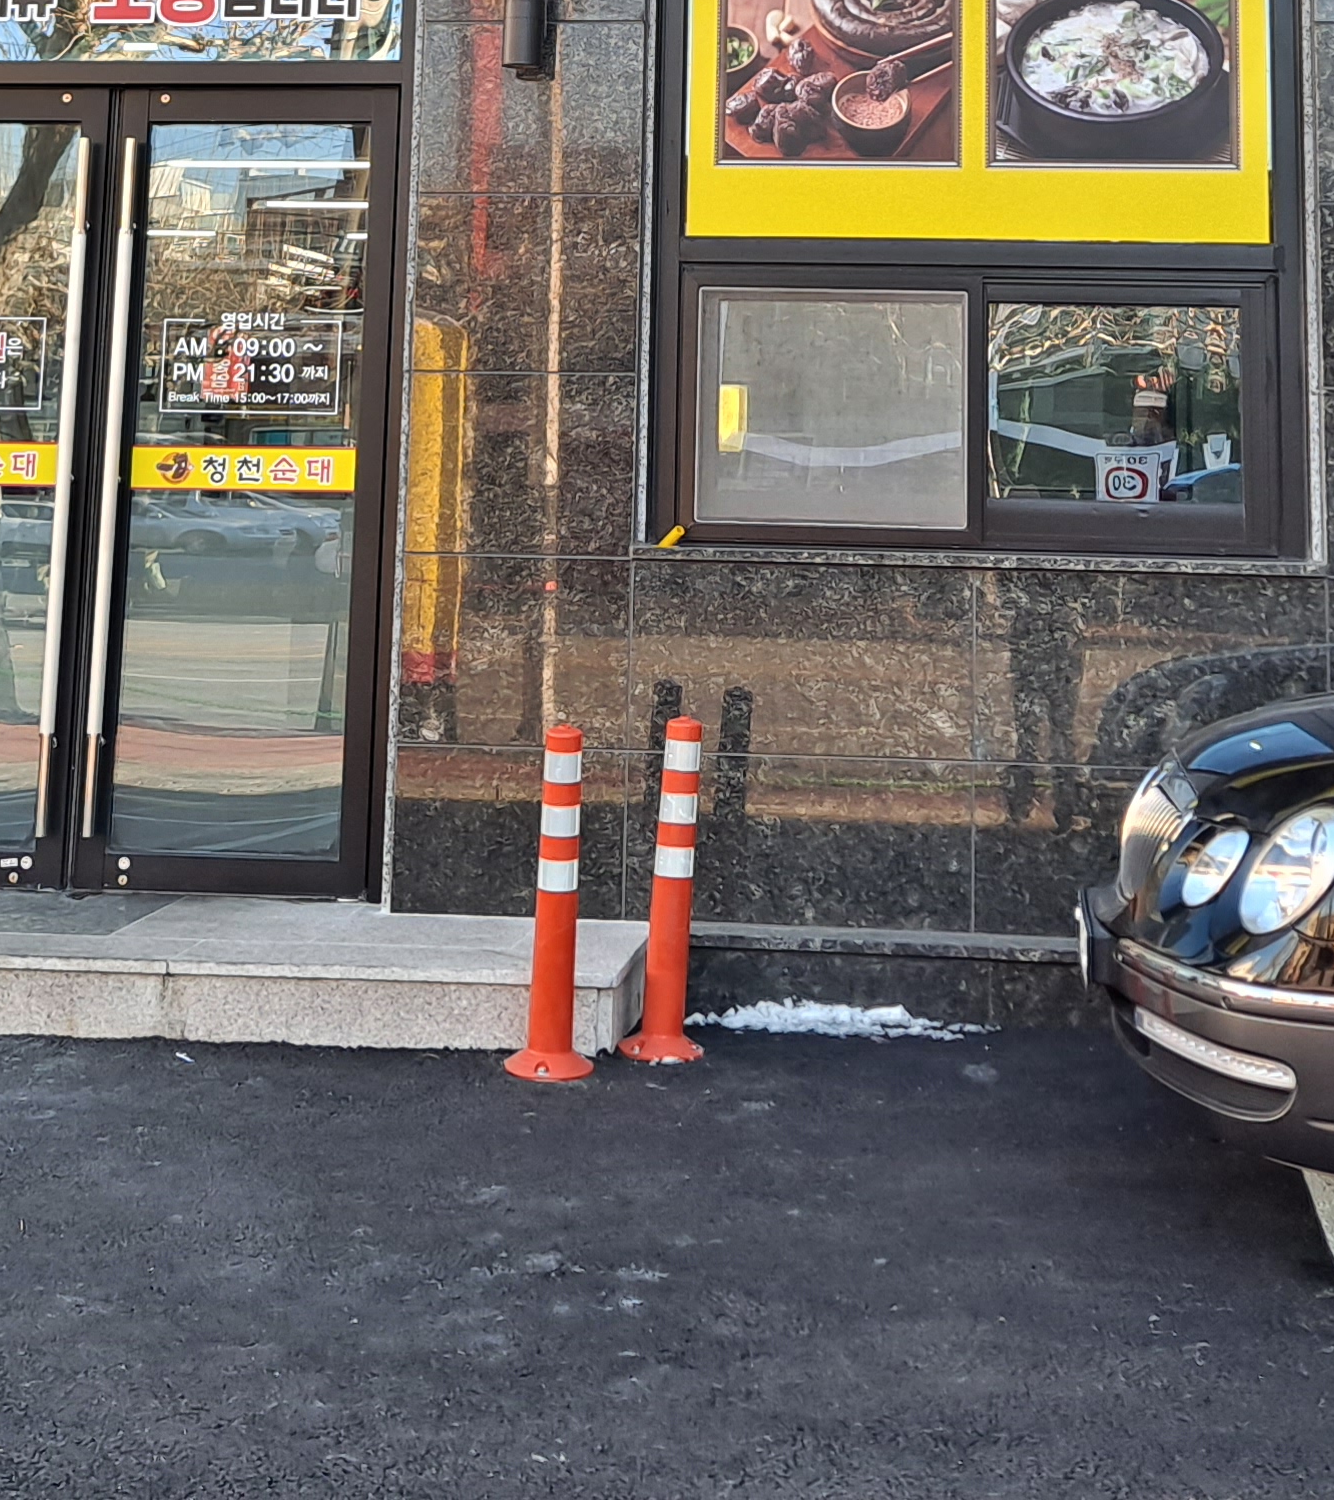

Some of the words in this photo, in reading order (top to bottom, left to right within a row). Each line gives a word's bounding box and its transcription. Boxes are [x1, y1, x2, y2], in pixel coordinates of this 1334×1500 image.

[220, 312, 286, 331] 영업시간
[173, 337, 208, 357] AM
[232, 337, 296, 358] 09:00
[172, 362, 204, 382] PM
[232, 363, 296, 383] 21:30
[300, 365, 329, 381] 까지
[167, 391, 201, 404] Break
[203, 392, 230, 404] Time
[202, 456, 332, 484] 청천순대
